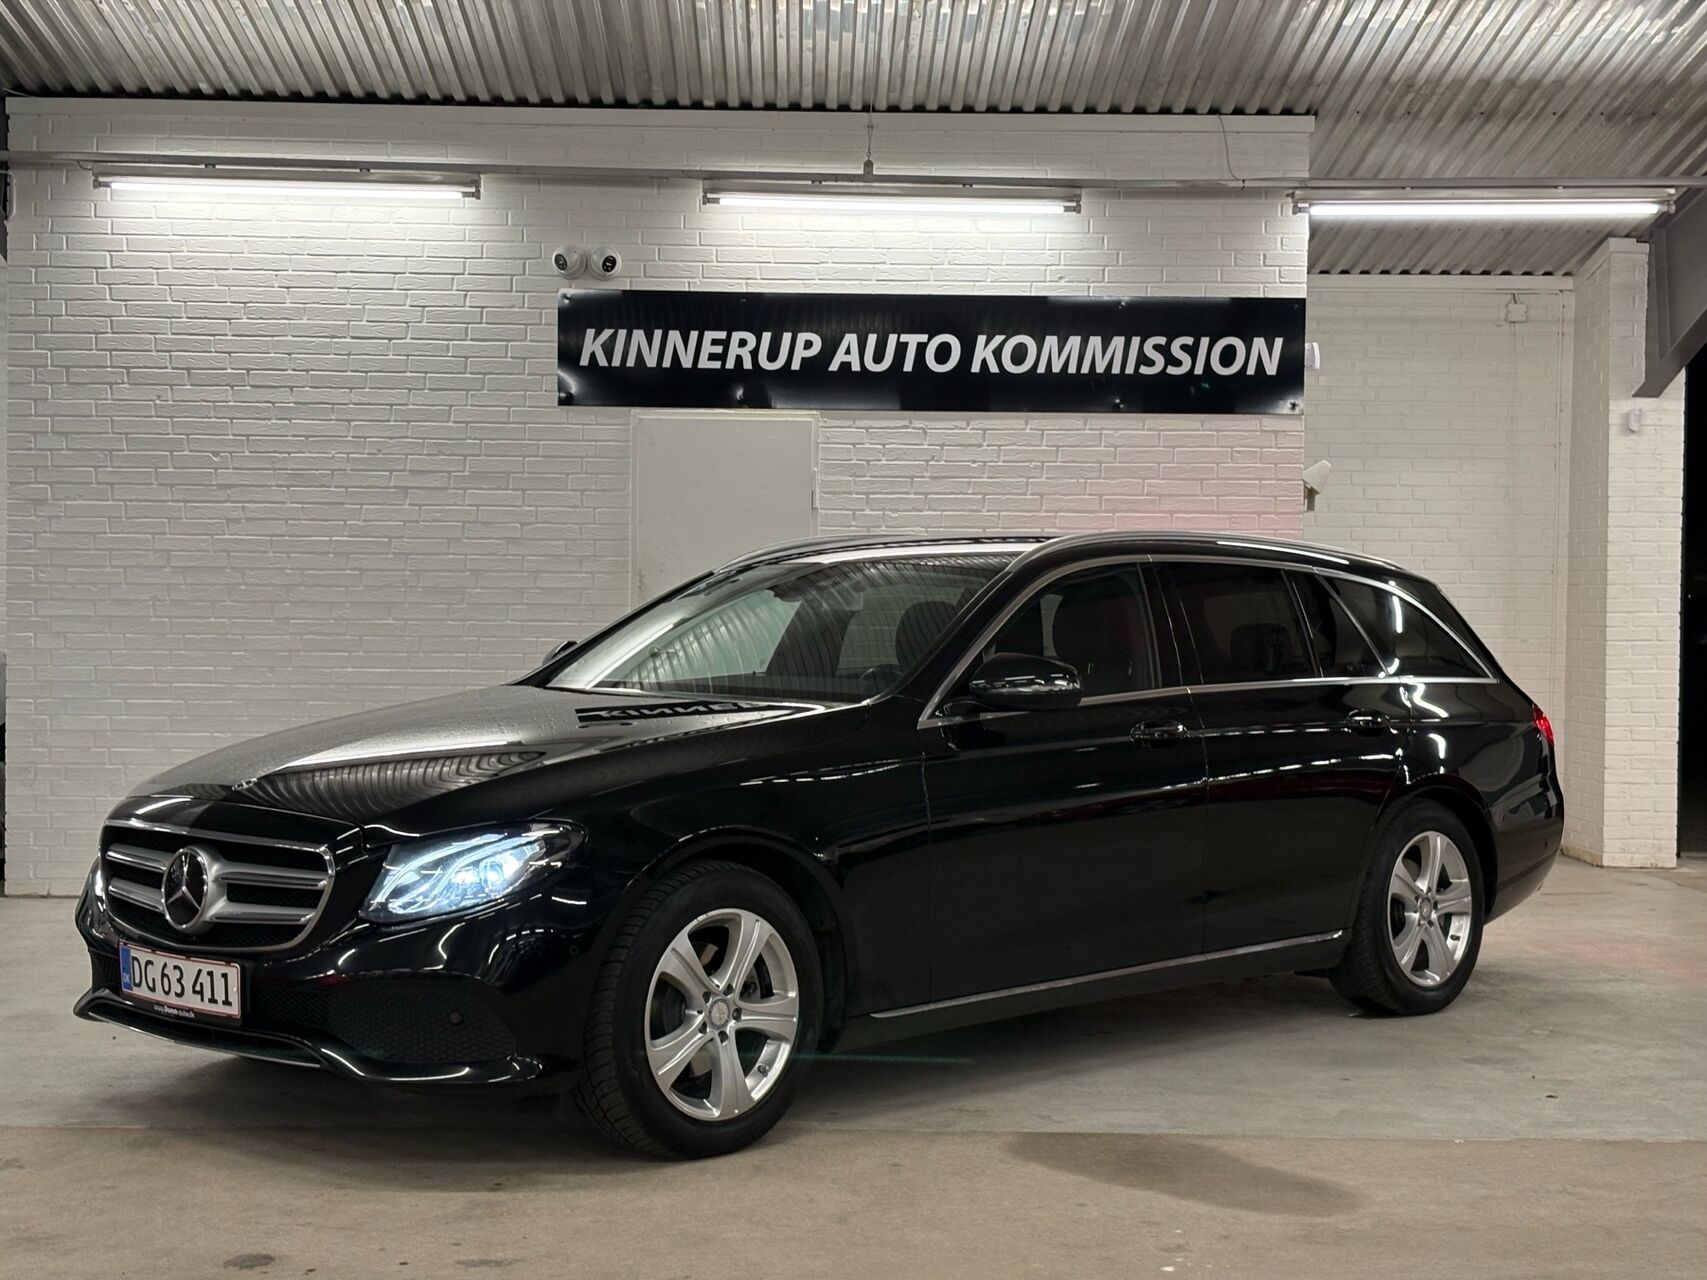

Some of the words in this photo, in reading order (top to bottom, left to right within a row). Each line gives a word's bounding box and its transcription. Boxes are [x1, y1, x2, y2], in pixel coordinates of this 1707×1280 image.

[579, 328, 822, 371] KINNERUP
[828, 333, 961, 373] AUTO
[971, 335, 1283, 375] KOMMISSION
[132, 956, 156, 993] DG
[160, 961, 186, 998] 63
[192, 968, 232, 1006] 411
